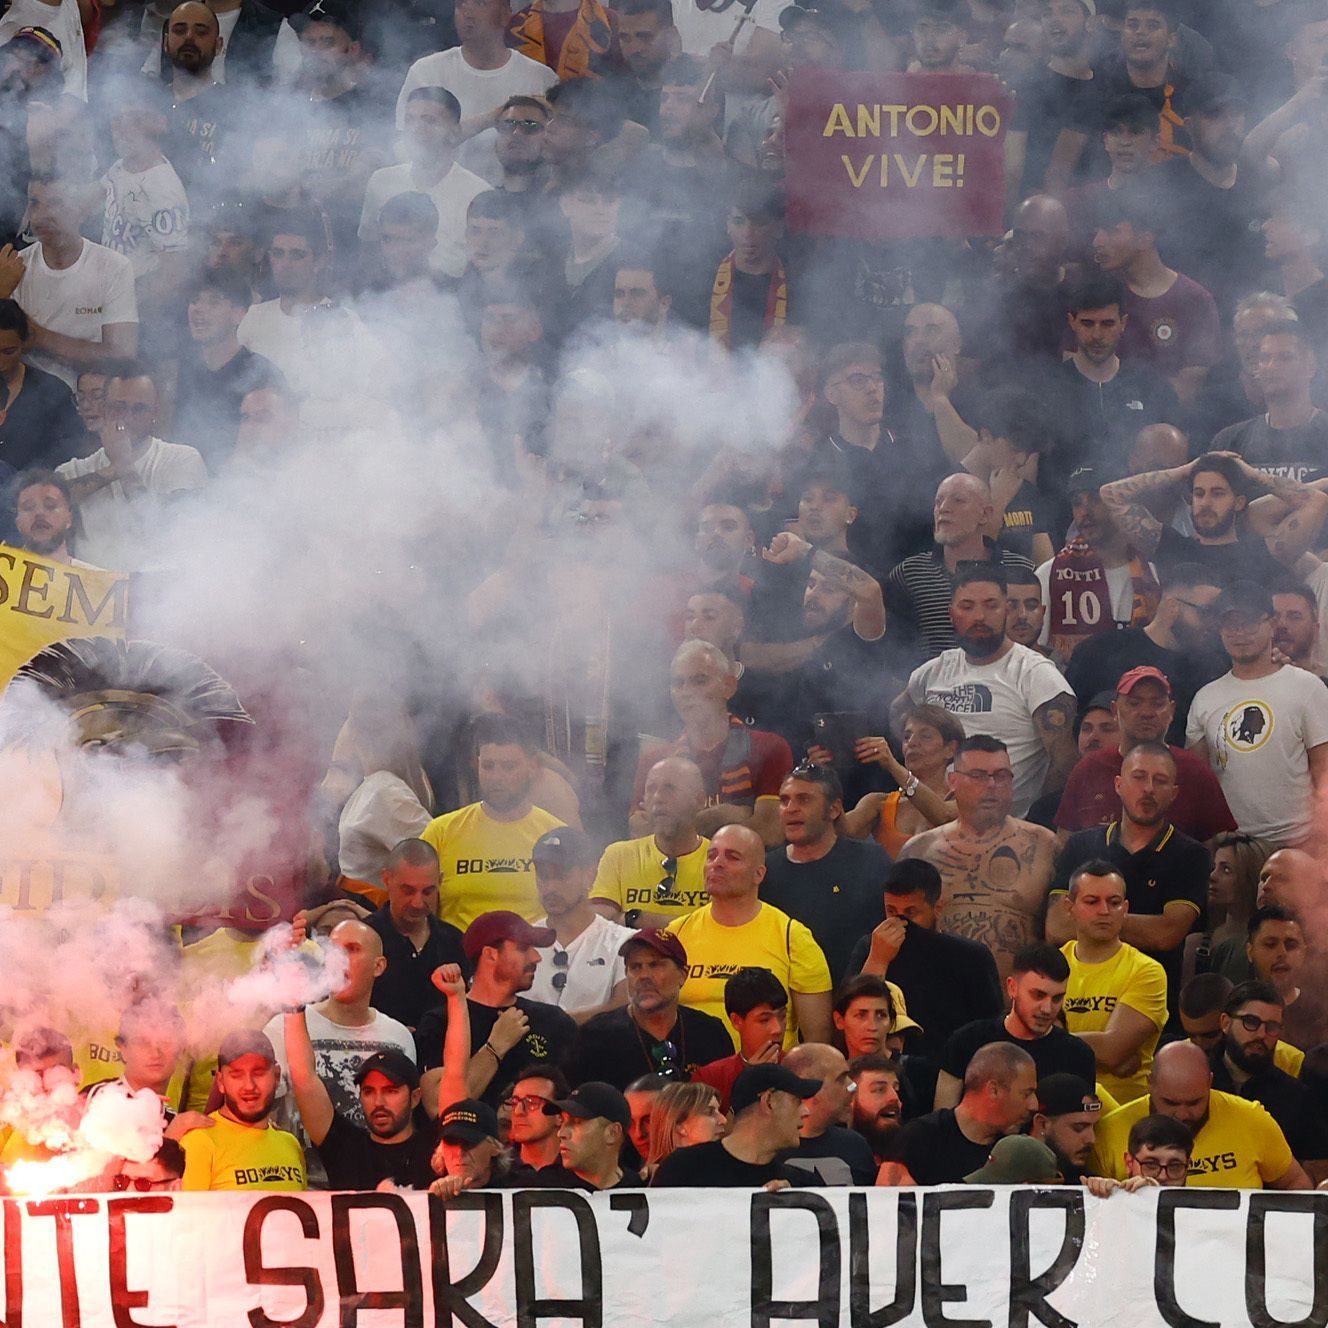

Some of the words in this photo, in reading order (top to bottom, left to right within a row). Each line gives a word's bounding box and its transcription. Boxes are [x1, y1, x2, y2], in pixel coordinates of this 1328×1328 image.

[823, 104, 1001, 139] ANTONIO
[840, 153, 965, 189] VIVE!
[1056, 568, 1101, 582] TOTTI
[1060, 590, 1102, 626] 10
[953, 686, 975, 698] THE
[243, 1190, 650, 1328] SARA'
[750, 1188, 1087, 1328] AVER
